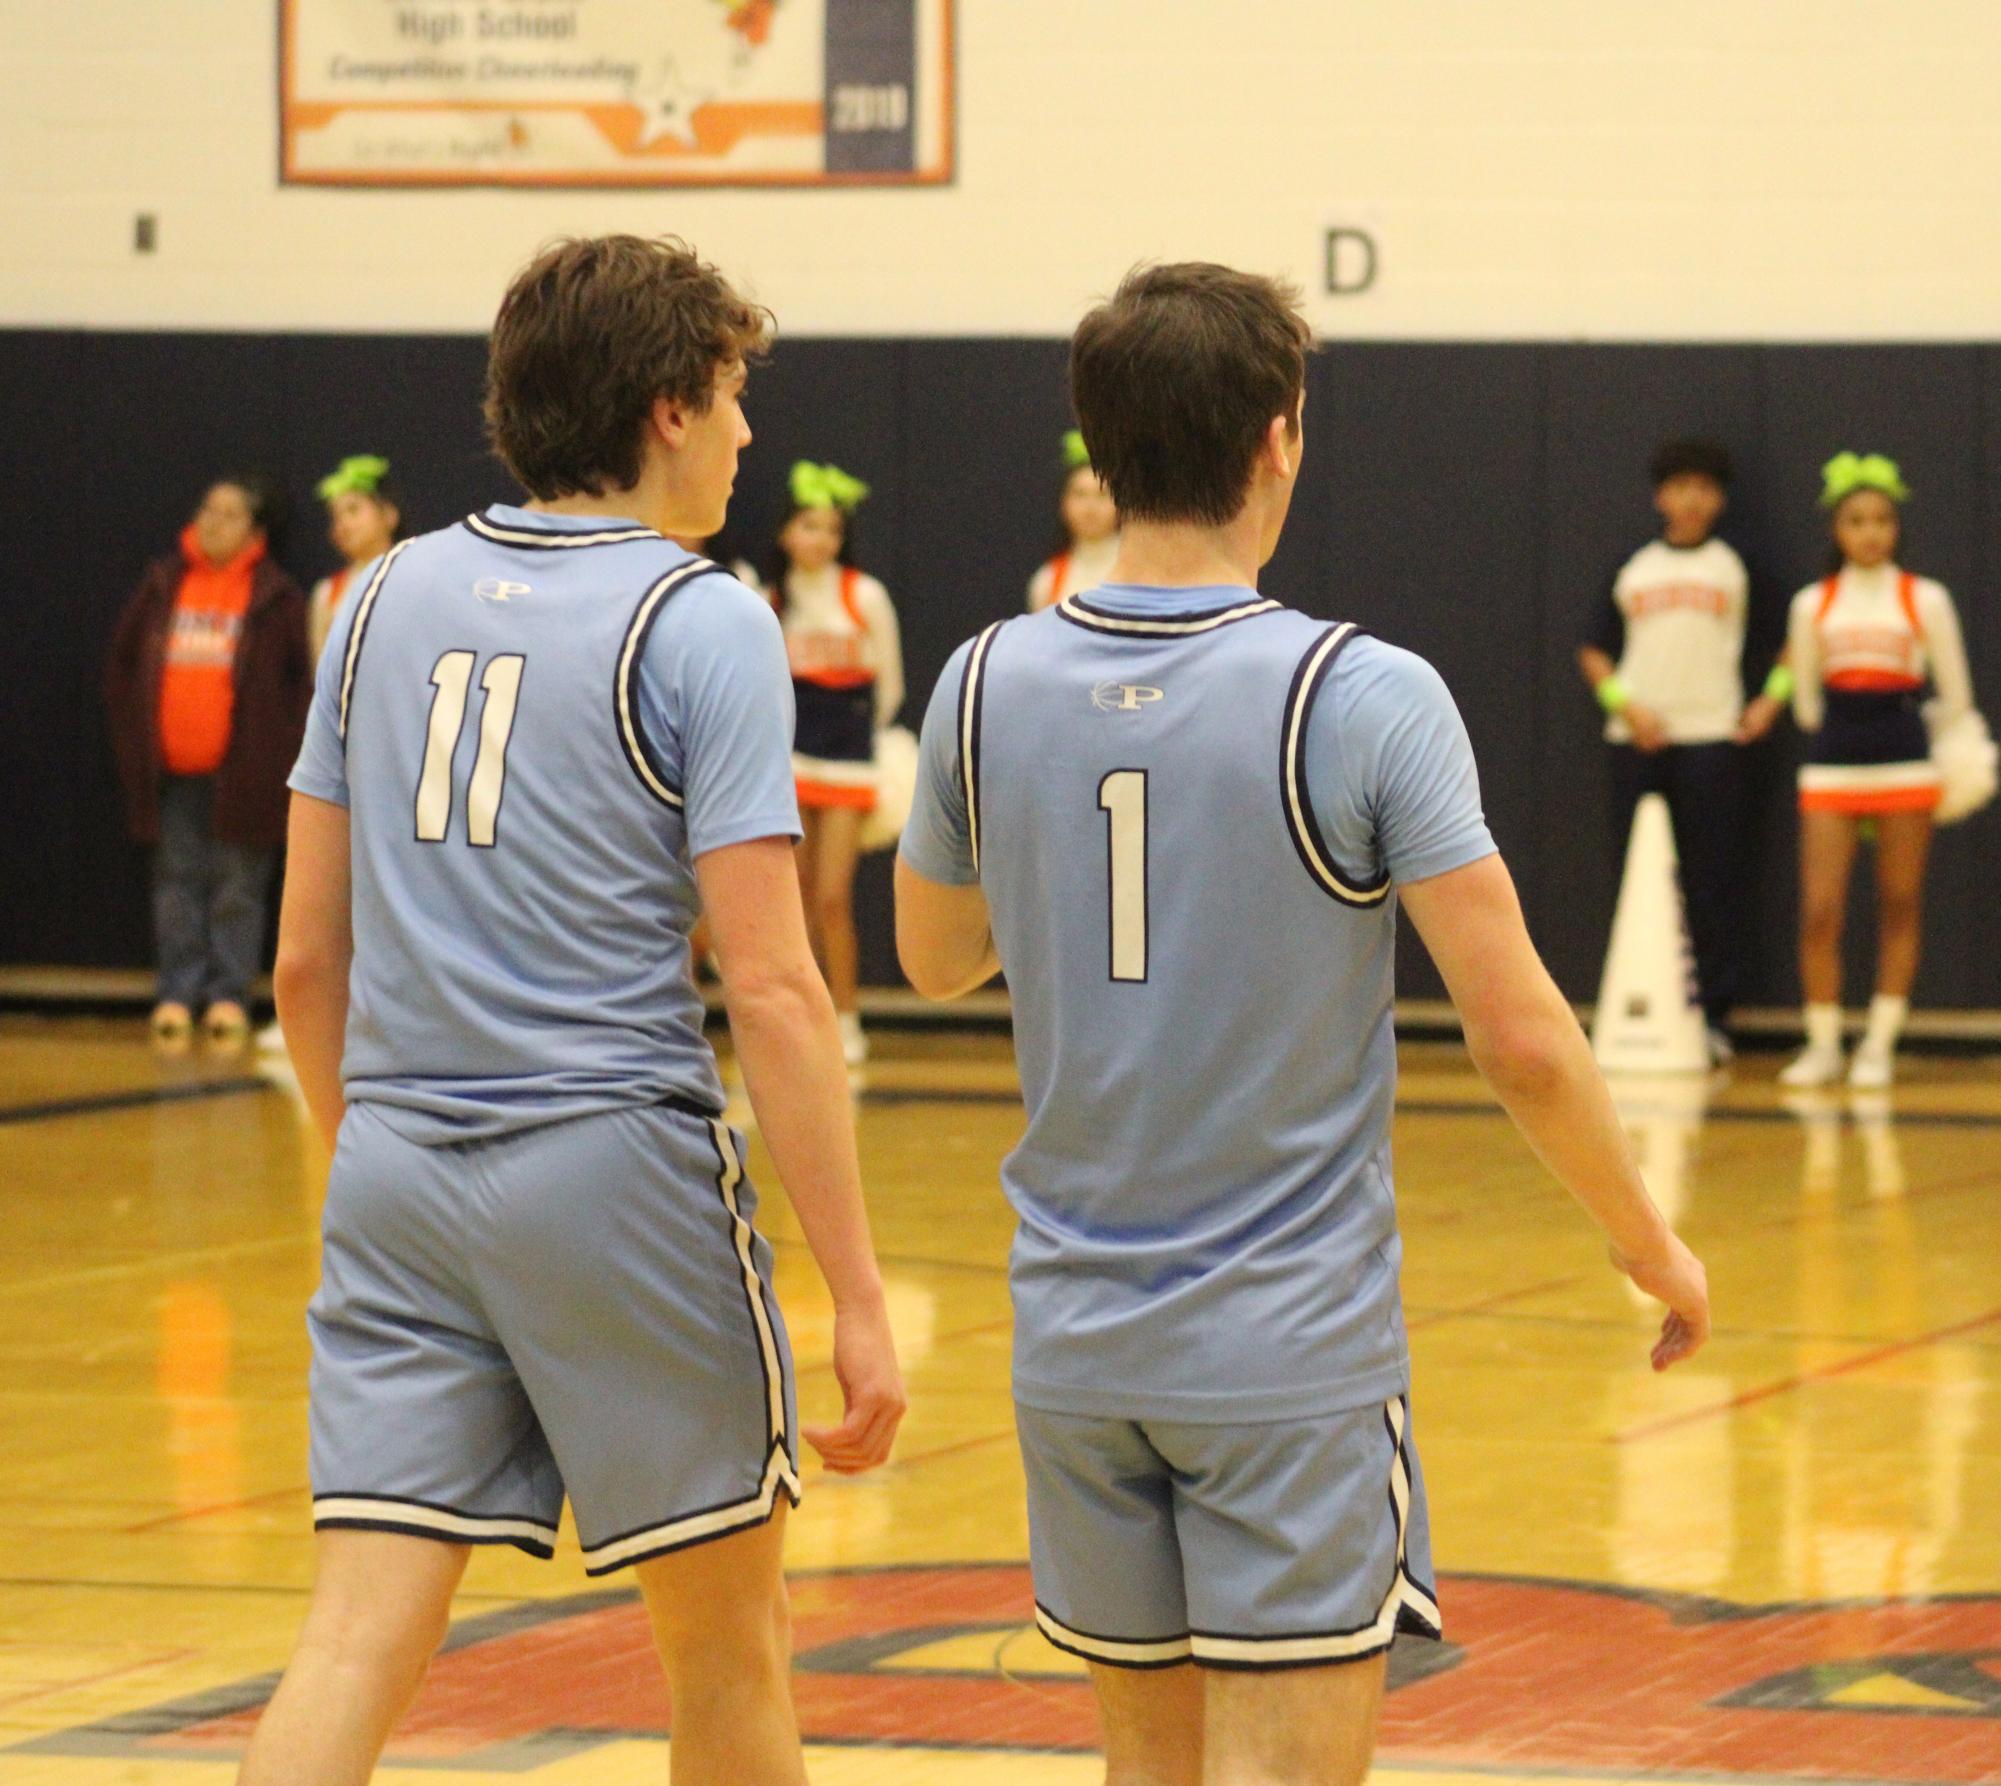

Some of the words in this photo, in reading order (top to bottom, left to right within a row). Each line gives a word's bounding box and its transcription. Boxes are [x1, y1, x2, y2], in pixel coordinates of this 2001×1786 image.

[396, 9, 464, 44] High
[478, 9, 577, 38] School
[1323, 227, 1377, 297] D
[1117, 683, 1165, 711] P
[414, 648, 527, 848] 11
[1097, 768, 1149, 984] 1
